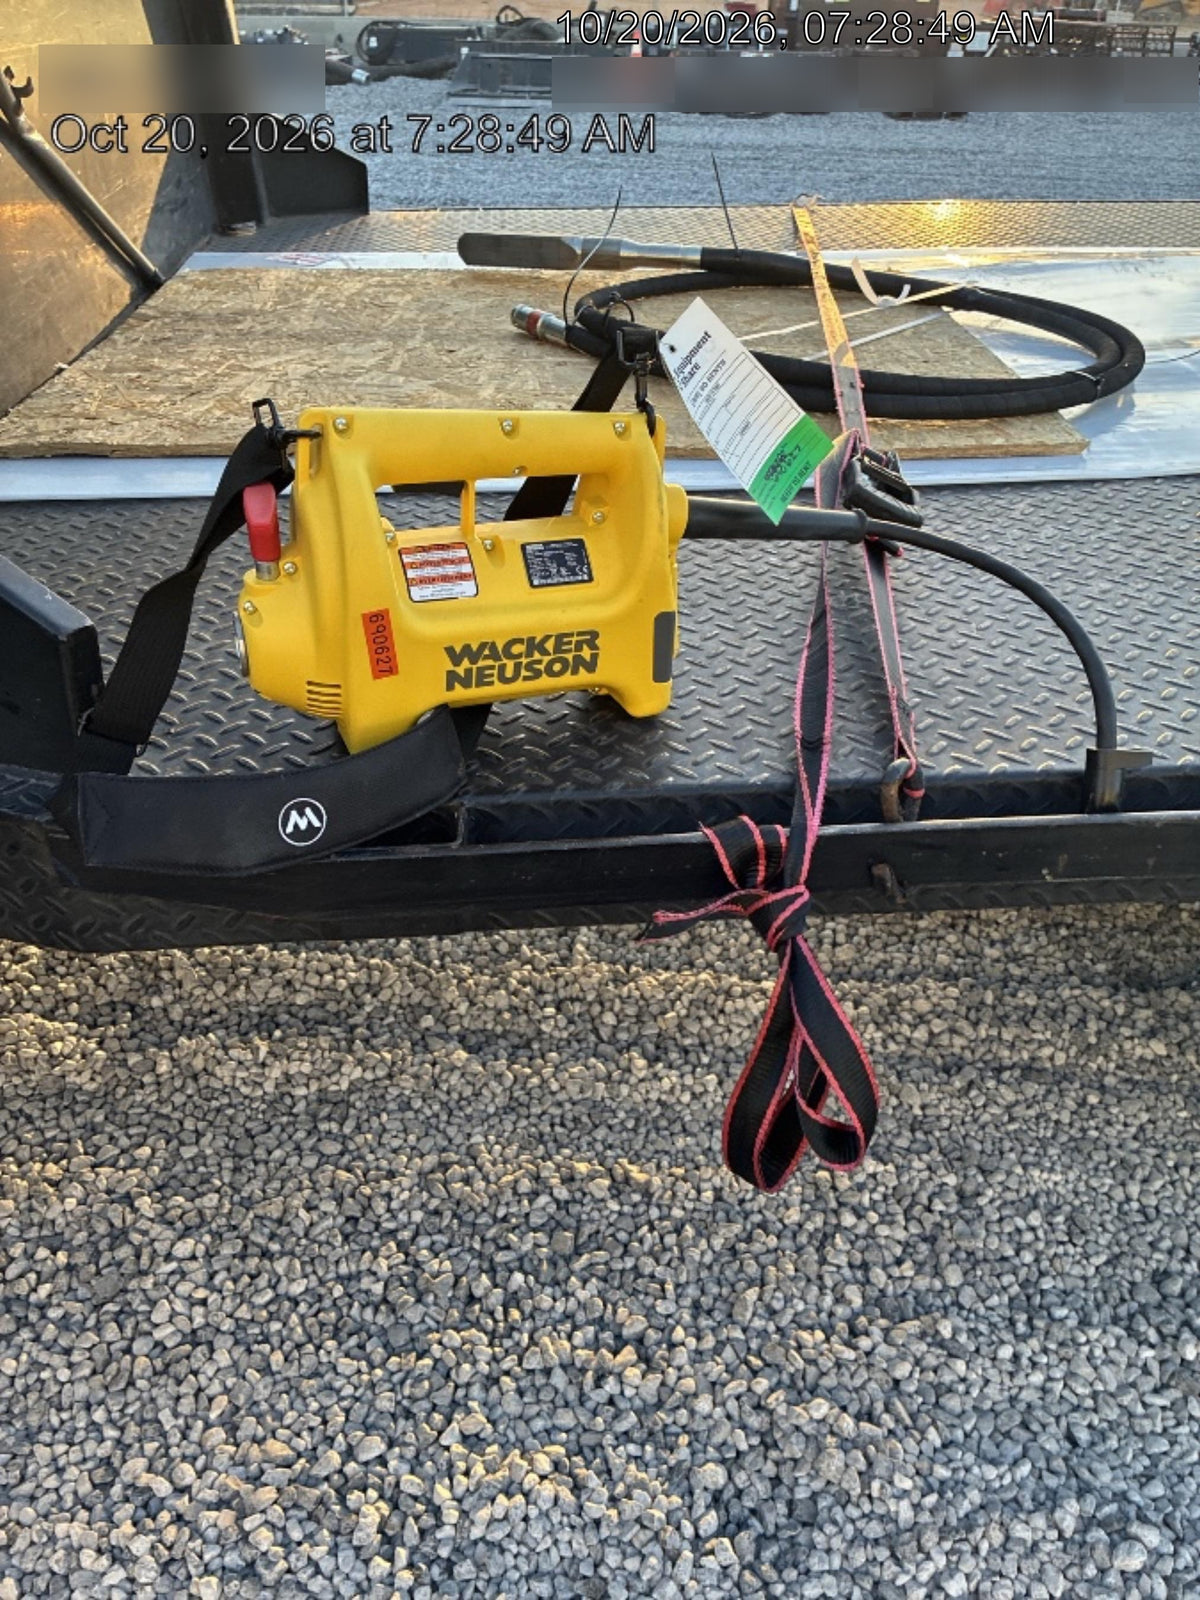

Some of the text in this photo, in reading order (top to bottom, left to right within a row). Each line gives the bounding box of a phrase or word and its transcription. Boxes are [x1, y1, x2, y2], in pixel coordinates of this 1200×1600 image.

[368, 612, 394, 674] 690627
[444, 630, 600, 667] WACKER
[446, 653, 600, 692] NEUSON
